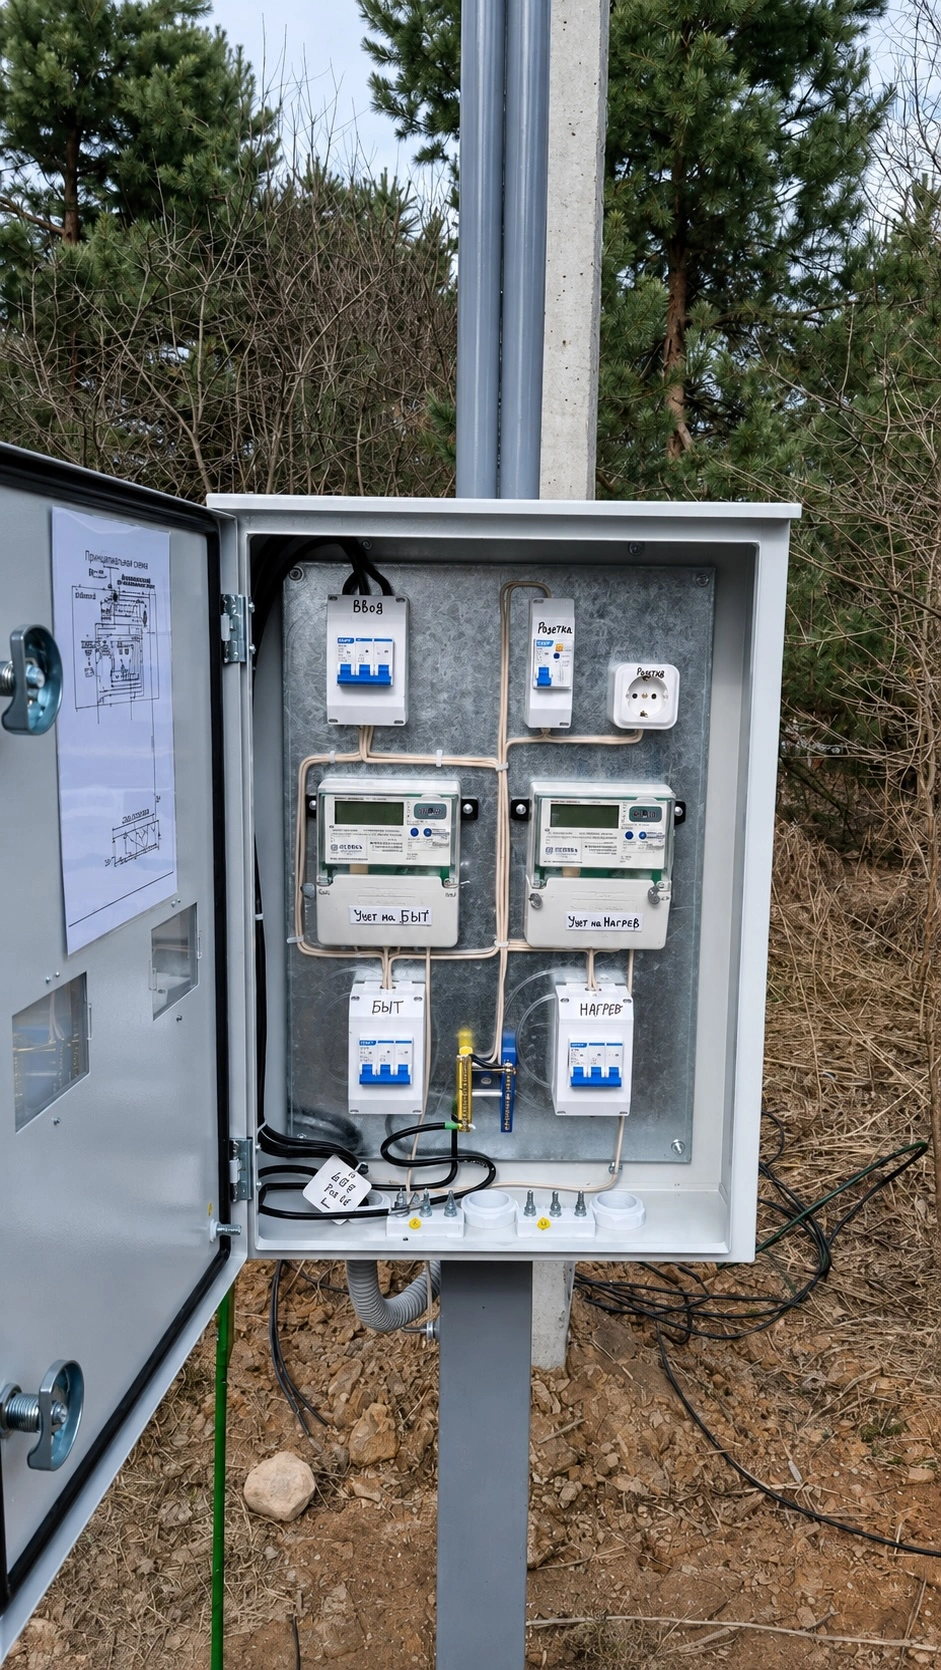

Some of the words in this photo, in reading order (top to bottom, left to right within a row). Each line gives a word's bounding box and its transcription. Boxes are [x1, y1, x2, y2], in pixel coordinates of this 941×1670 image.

[353, 599, 383, 615] Ввод
[381, 914, 396, 922] на
[371, 1000, 405, 1015] БЫТ
[580, 1002, 624, 1017] НАГРЕВ
